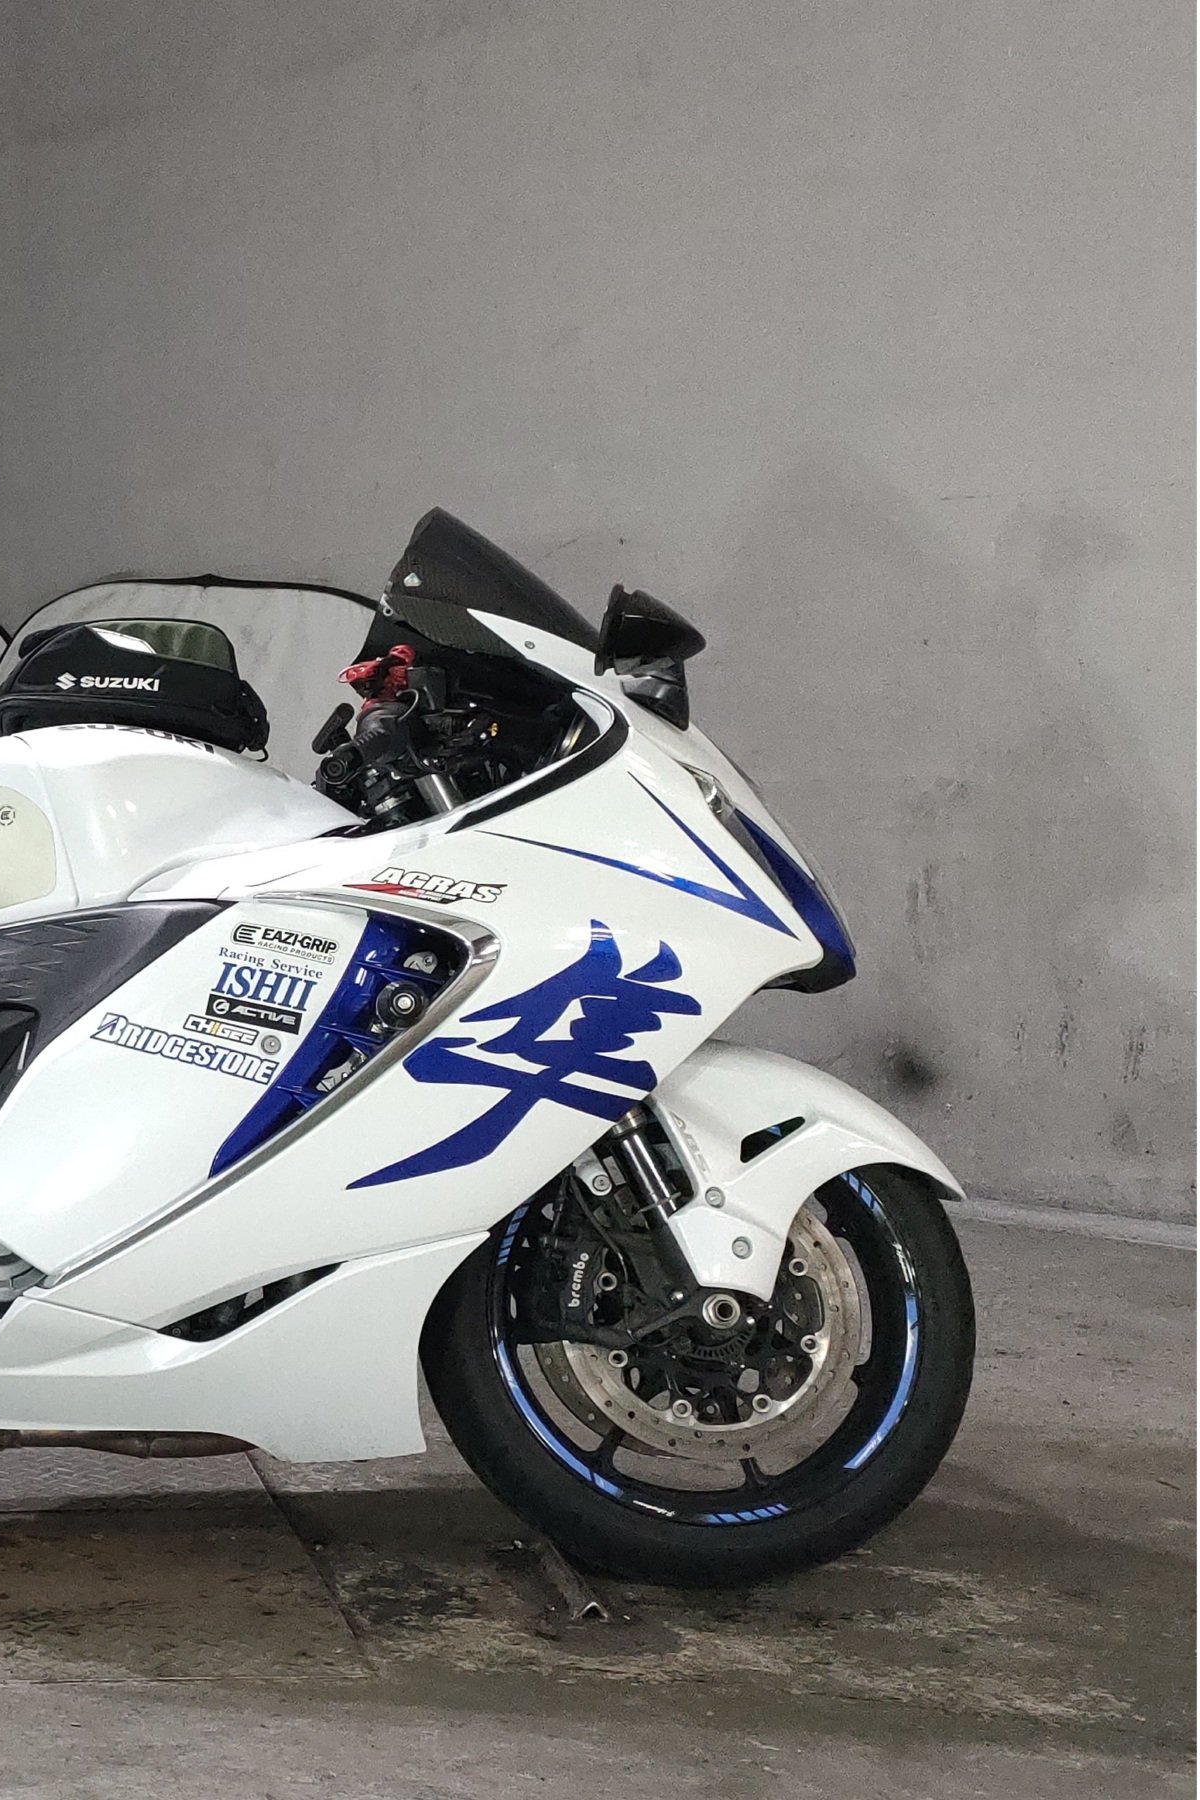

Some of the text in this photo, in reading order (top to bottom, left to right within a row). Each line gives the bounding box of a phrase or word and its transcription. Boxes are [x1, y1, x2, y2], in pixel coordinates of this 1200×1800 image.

[80, 676, 160, 692] SUZUKI
[371, 867, 502, 903] AGRAS
[257, 941, 333, 963] RACING PRODUCTS
[261, 928, 338, 954] EAZI-GRIP
[218, 947, 323, 979] Racing Service
[211, 962, 317, 1011] ISHII
[232, 1005, 296, 1026] ACTIVE
[90, 1012, 279, 1085] BRIDGESTONE
[568, 1252, 589, 1307] brembo
